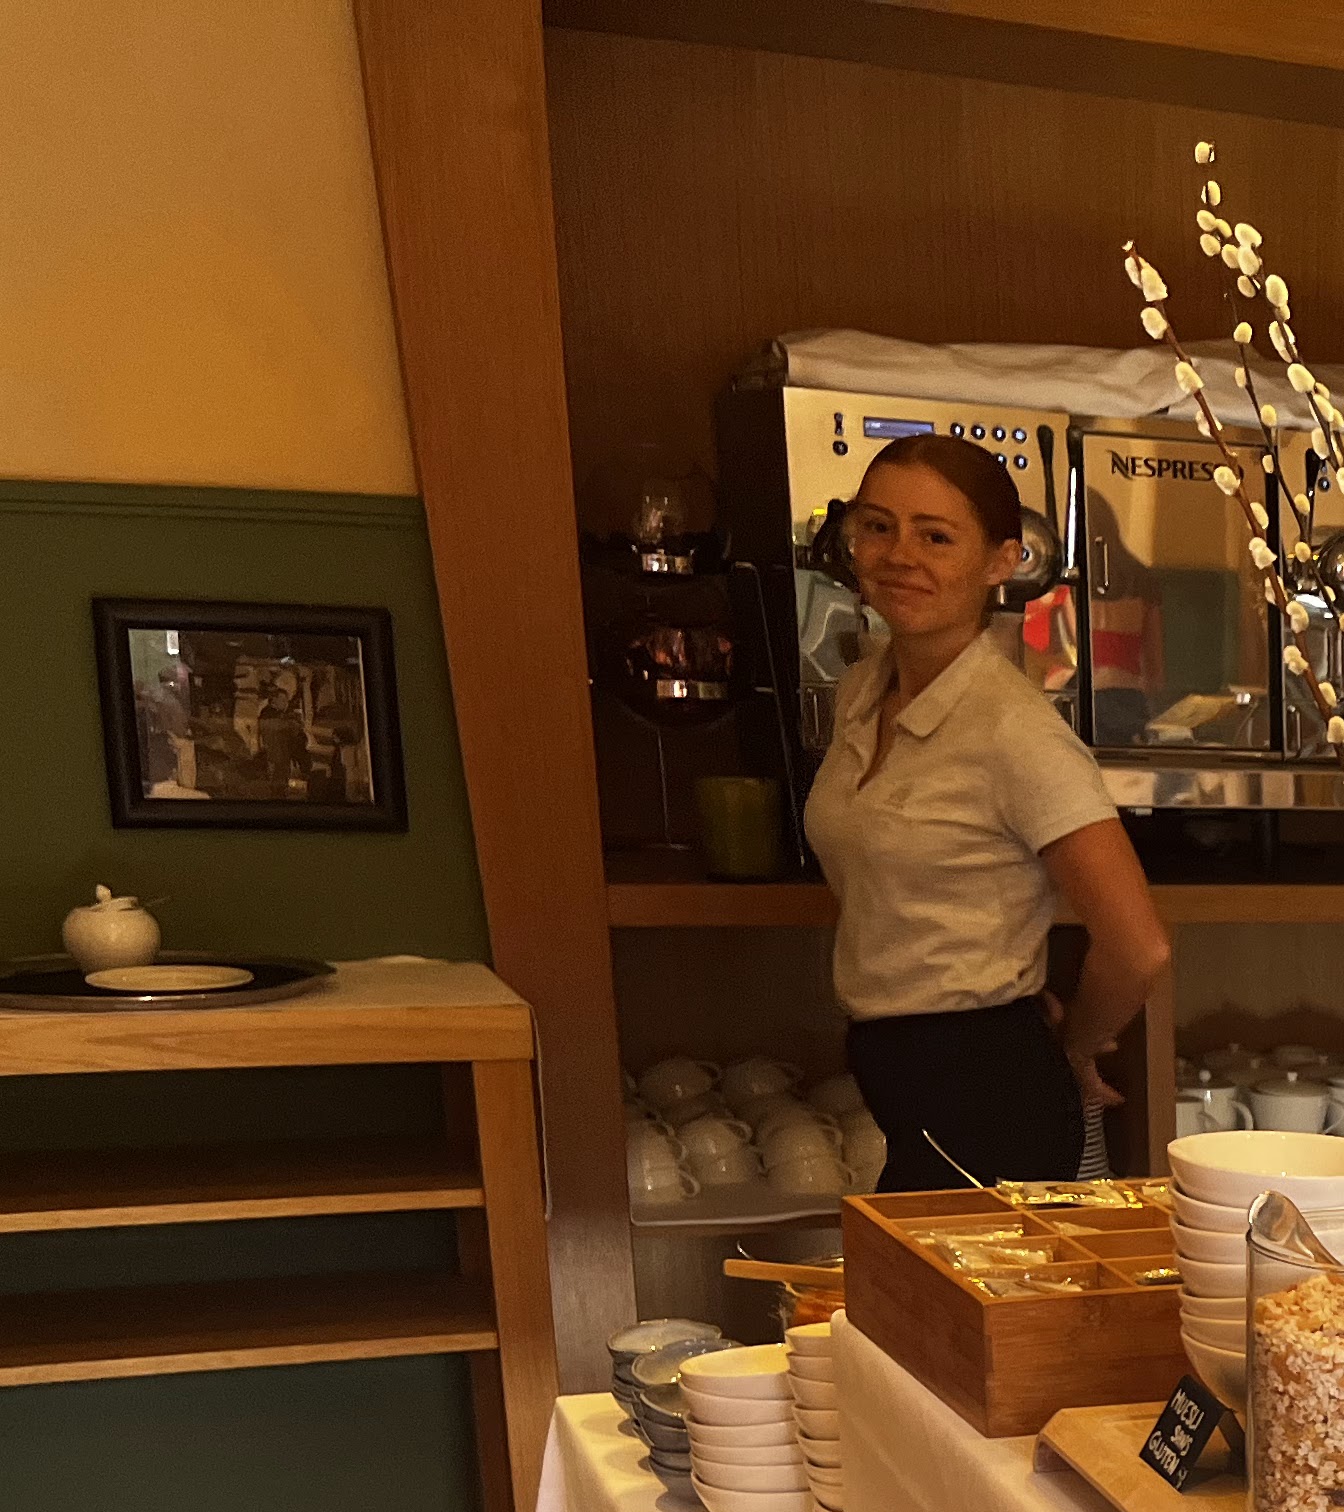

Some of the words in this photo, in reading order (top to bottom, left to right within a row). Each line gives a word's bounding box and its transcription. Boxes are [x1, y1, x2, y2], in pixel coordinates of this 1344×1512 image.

[1106, 449, 1245, 482] NESPRES
[1170, 1387, 1205, 1431] MUESLI
[1148, 1430, 1180, 1477] GLUTEN
[1170, 1424, 1194, 1457] SANS
